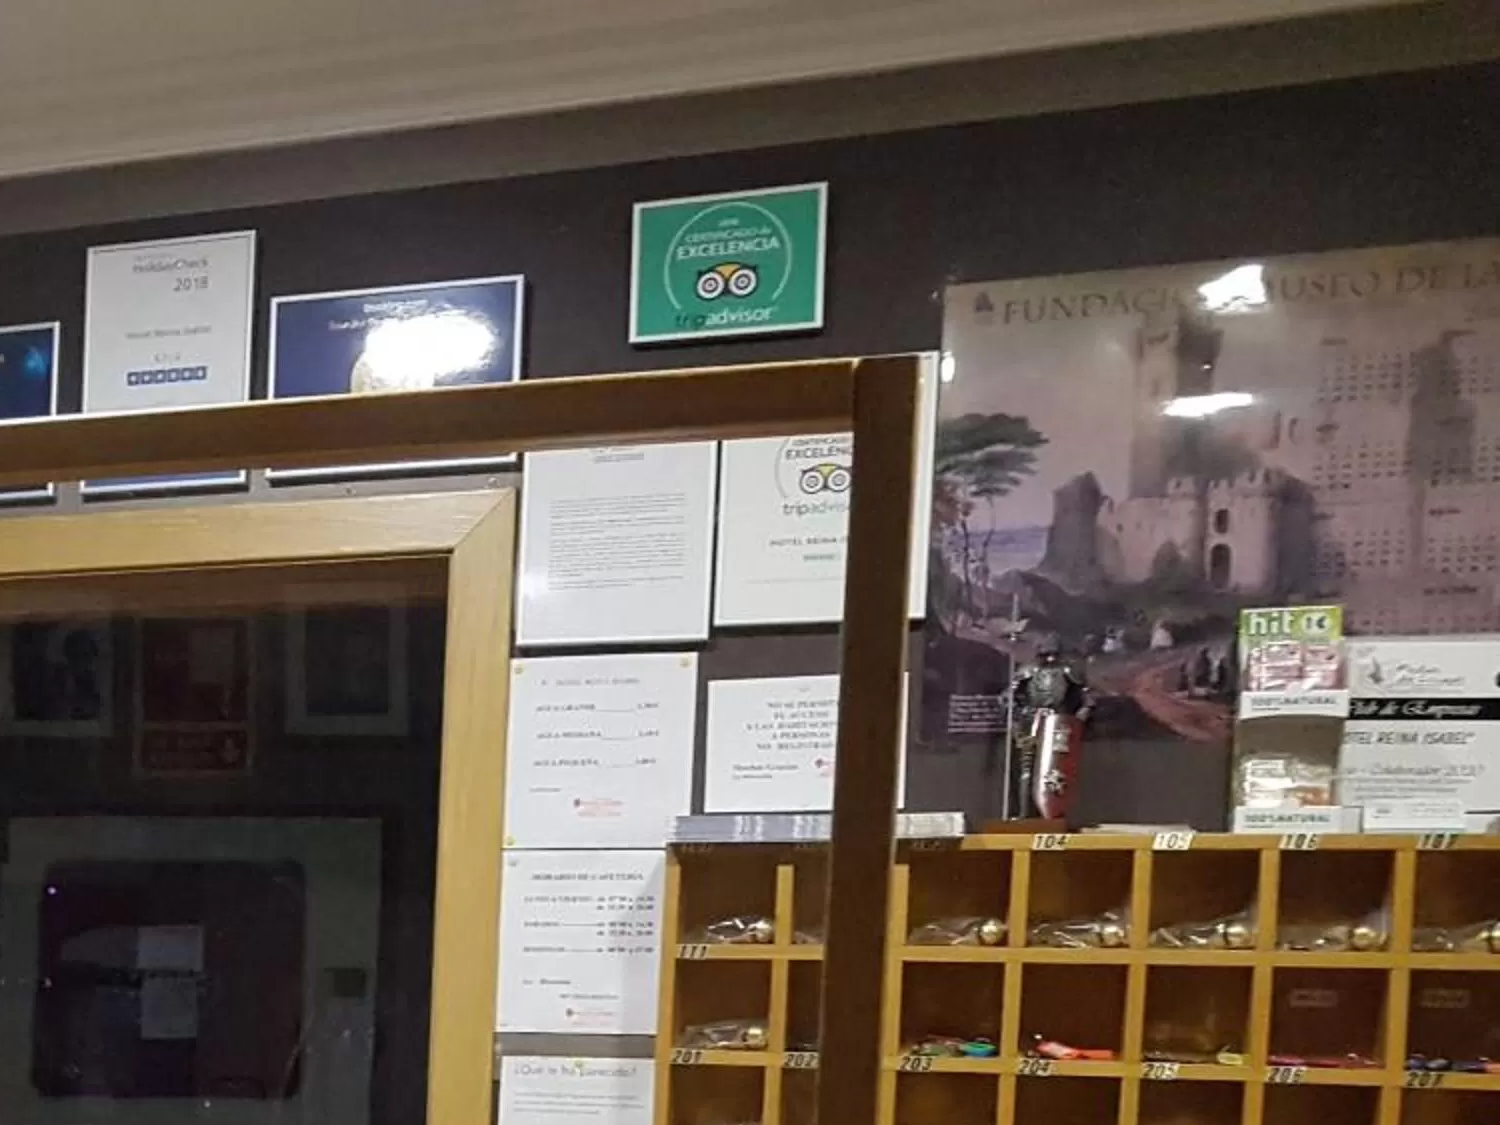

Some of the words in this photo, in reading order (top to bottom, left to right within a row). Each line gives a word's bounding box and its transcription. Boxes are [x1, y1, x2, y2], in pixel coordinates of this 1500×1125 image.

[676, 236, 781, 261] EXCELENCIA
[675, 305, 773, 330] tripadvisor
[1249, 611, 1294, 635] hit
[1035, 835, 1067, 849] 104
[672, 1050, 702, 1064] 201
[900, 1056, 933, 1071] 203
[1019, 1059, 1051, 1075] 204
[1407, 1072, 1444, 1088] 207
